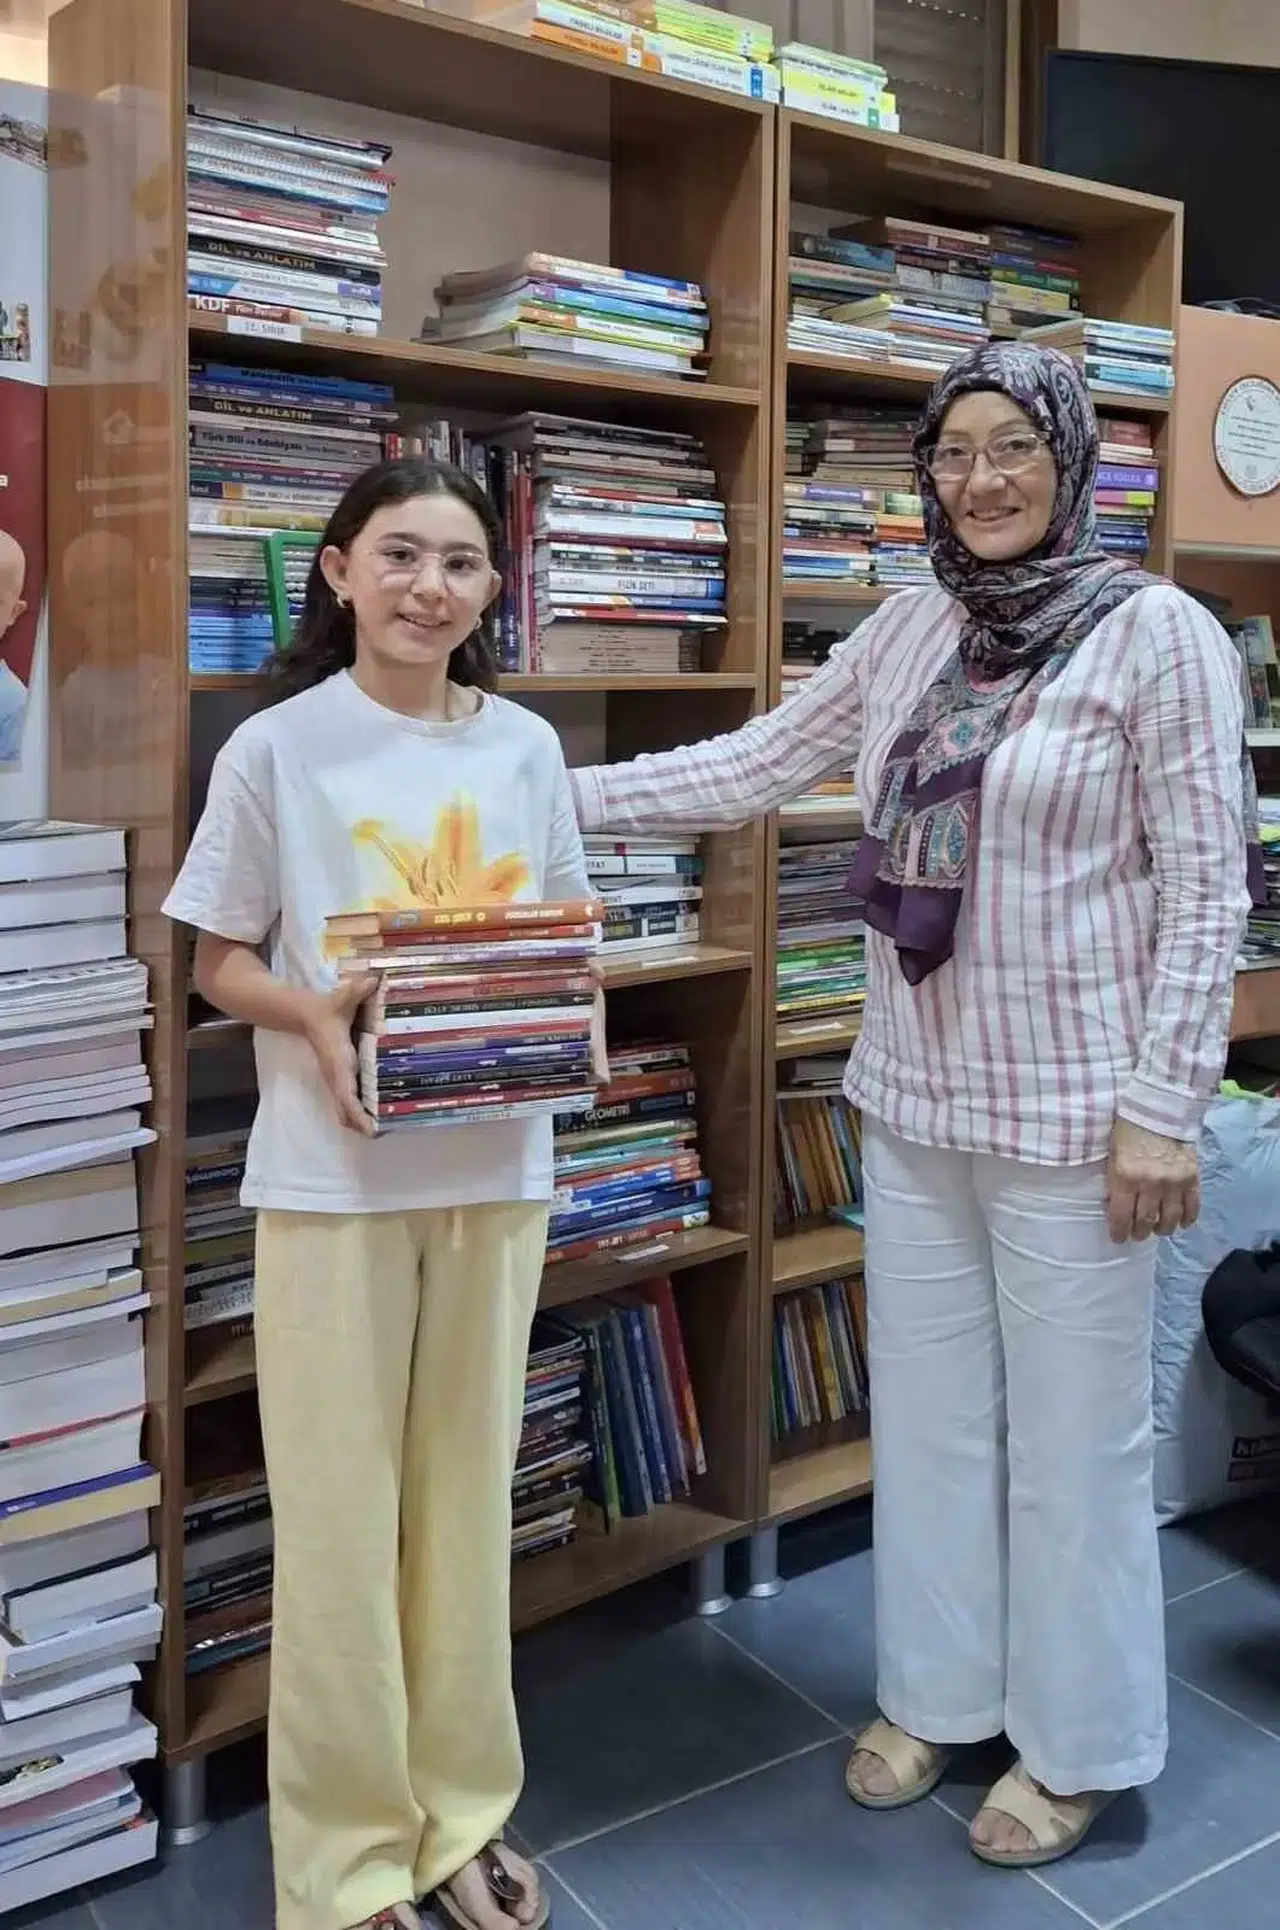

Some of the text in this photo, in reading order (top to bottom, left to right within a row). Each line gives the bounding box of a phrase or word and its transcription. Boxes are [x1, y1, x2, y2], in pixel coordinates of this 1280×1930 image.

[251, 248, 316, 272] ANLATIM
[213, 400, 236, 413] DİL
[255, 406, 313, 421] ANLATIM
